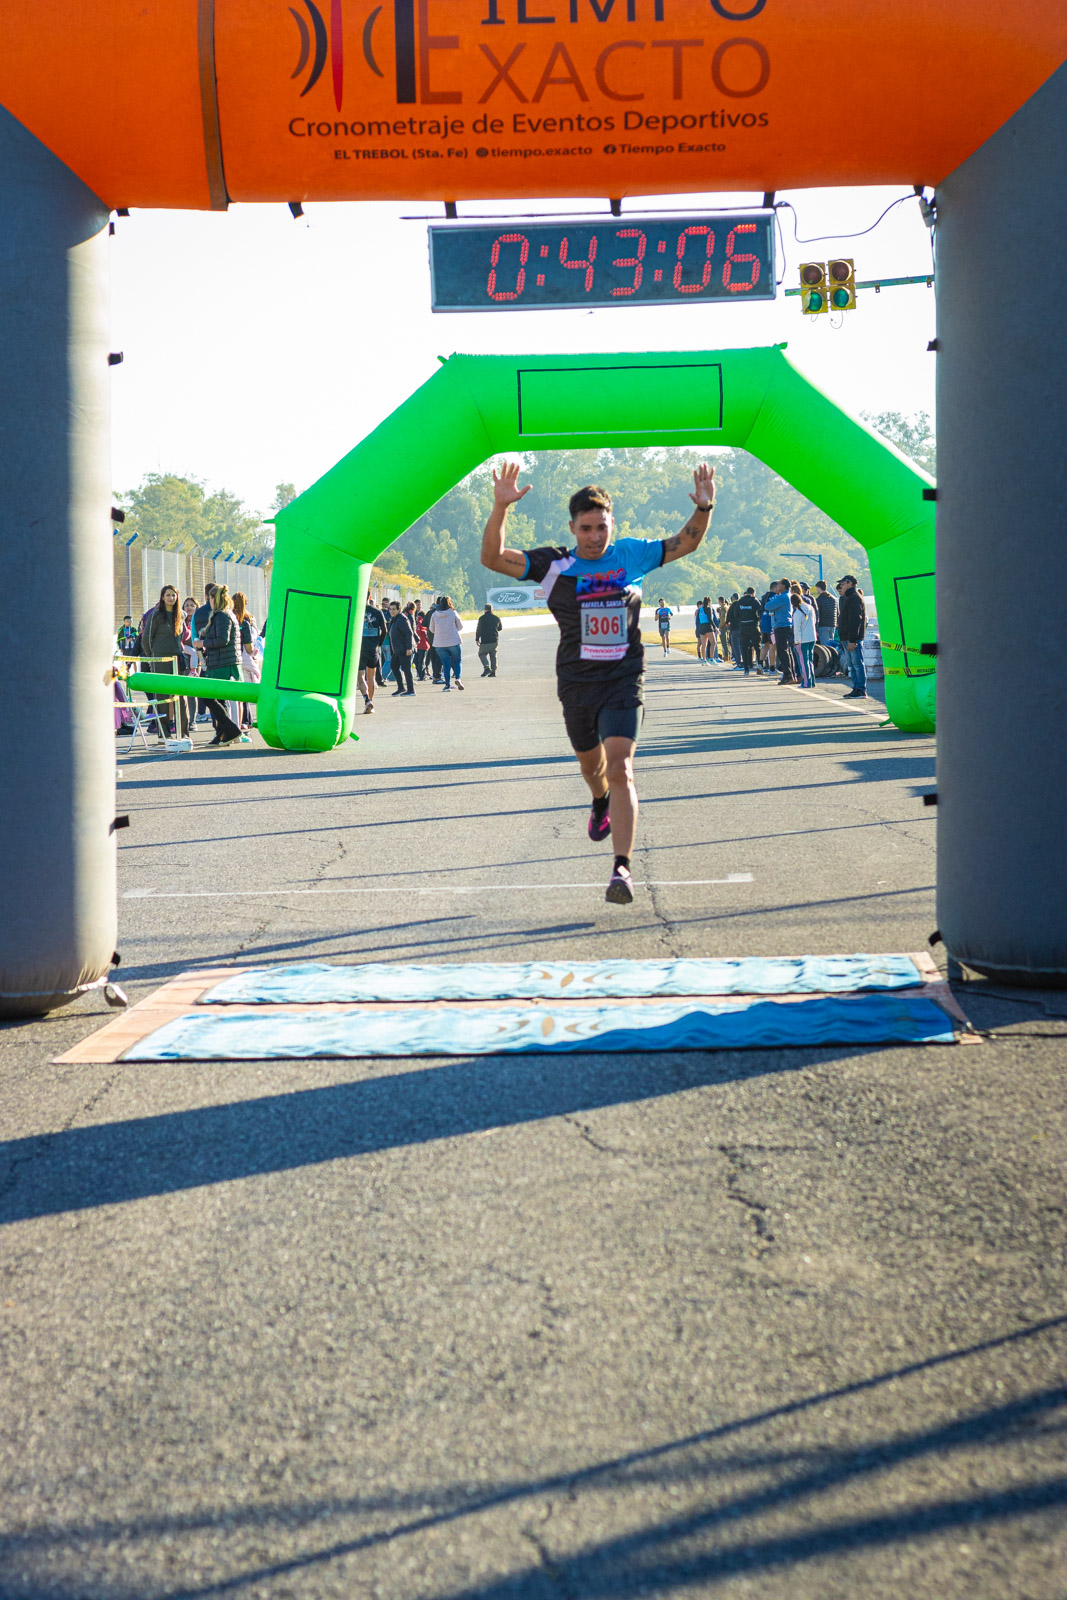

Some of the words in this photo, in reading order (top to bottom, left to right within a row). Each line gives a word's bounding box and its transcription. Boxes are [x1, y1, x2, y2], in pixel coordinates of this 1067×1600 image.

[419, 0, 771, 104] EXACTO
[288, 116, 465, 139] Cronometraje
[472, 113, 504, 134] de
[512, 113, 612, 133] Eventos
[623, 109, 769, 134] Deportivos
[334, 150, 348, 160] EL
[352, 149, 409, 160] TREBOL
[412, 148, 444, 160] (Sta.
[447, 147, 468, 159] Fe)
[491, 146, 593, 159] tiempo.exacto
[619, 143, 674, 156] Tiempo
[678, 142, 726, 153] Exacto
[486, 223, 761, 301] 0:43:06
[497, 592, 521, 603] Ford
[590, 616, 619, 635] 306
